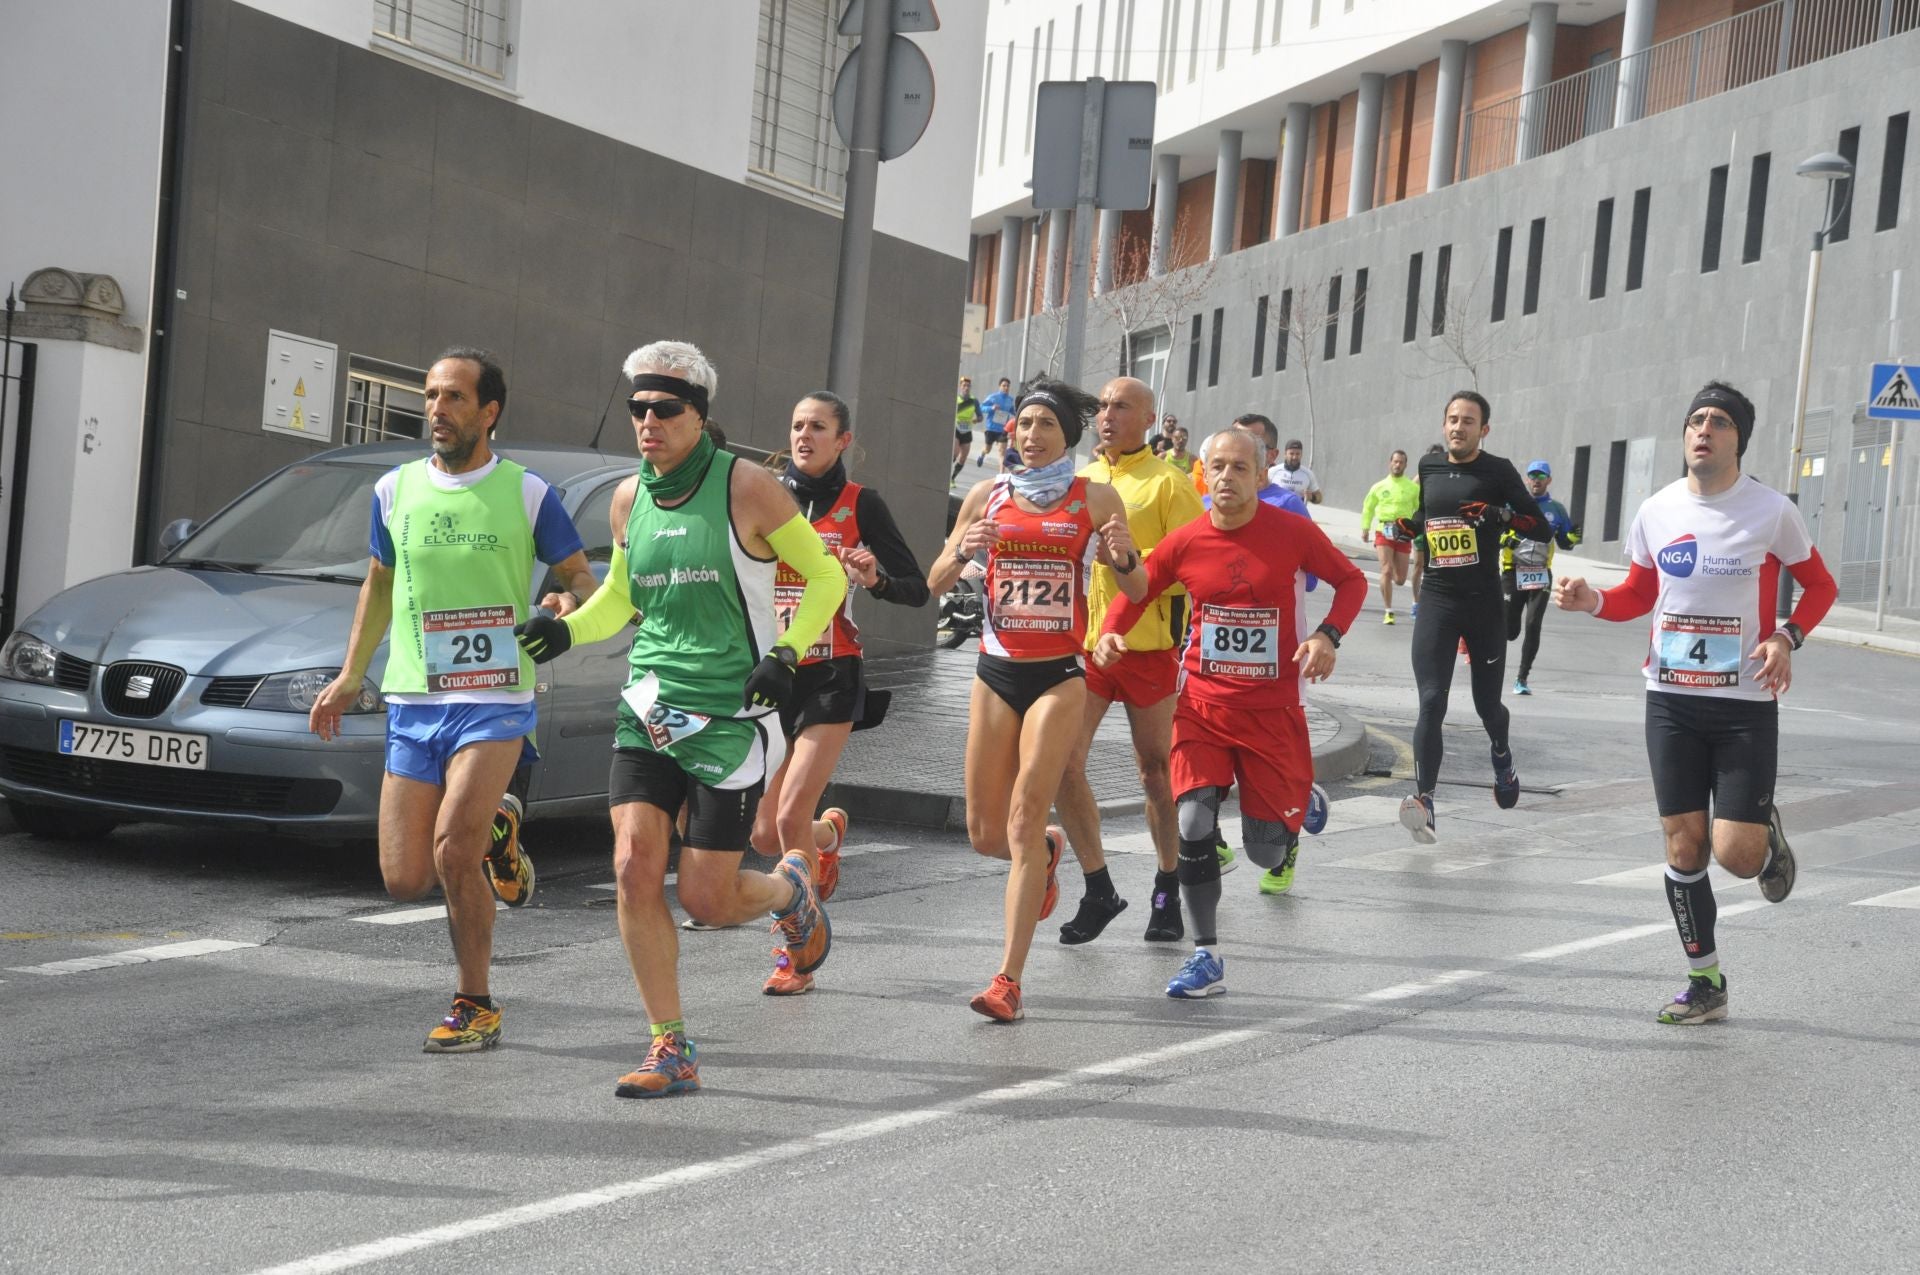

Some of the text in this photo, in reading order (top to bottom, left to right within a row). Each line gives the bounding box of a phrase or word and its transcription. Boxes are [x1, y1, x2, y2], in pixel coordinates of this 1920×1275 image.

[401, 514, 410, 546] future
[424, 533, 498, 544] EL GRUPO
[403, 549, 412, 583] better
[1661, 551, 1693, 564] NGA
[1703, 555, 1741, 565] Human
[631, 564, 719, 587] Team Halcón
[1522, 573, 1543, 582] 207
[1702, 566, 1752, 576] Resources
[999, 580, 1071, 607] 2124
[444, 612, 458, 620] Gran
[459, 611, 478, 619] Premio
[488, 609, 505, 617] Fondo
[1001, 616, 1059, 631] Cruzcampo
[411, 614, 422, 660] working
[1214, 626, 1267, 653] 892
[451, 633, 493, 665] 29
[1689, 638, 1708, 664] 4
[1209, 661, 1266, 678] Cruzcampo
[1668, 670, 1726, 686] Cruzcampo
[439, 673, 506, 688] Cruzcampo
[74, 726, 202, 764] 7775 DRG
